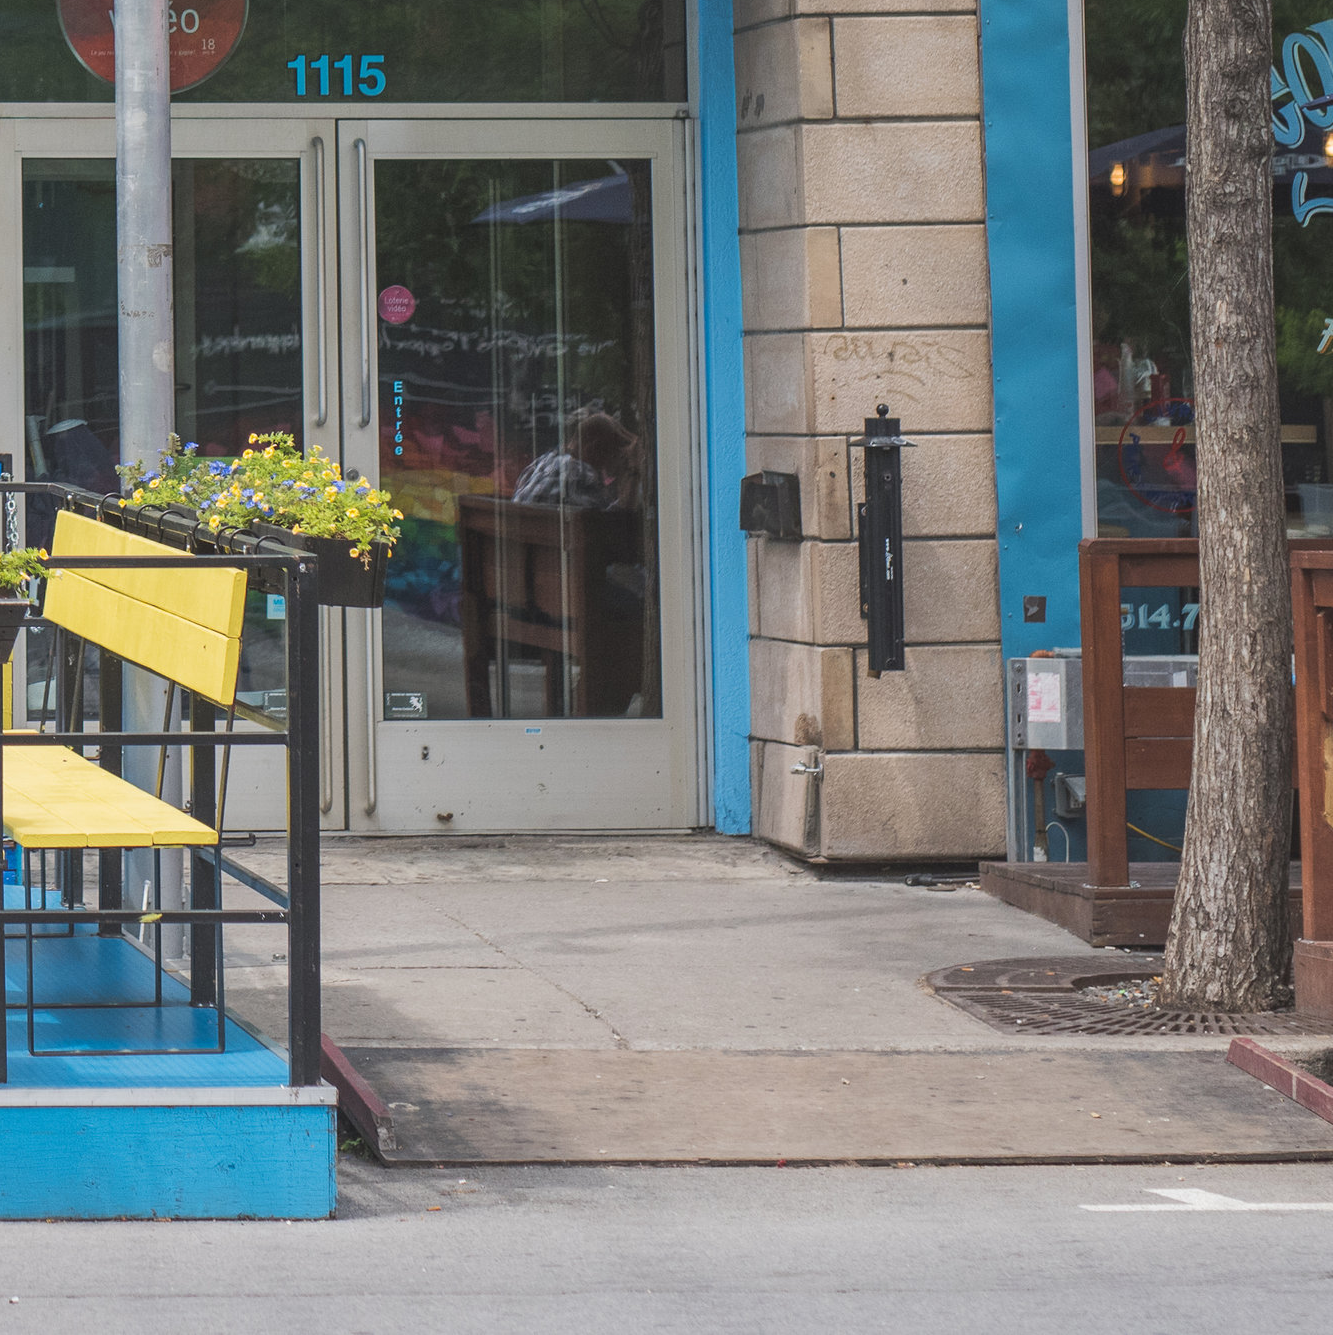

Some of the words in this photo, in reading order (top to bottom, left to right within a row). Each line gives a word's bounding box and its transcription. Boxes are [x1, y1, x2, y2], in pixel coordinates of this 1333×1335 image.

[201, 38, 216, 51] 18
[287, 54, 387, 97] 1115
[384, 296, 409, 305] Loterie
[393, 381, 403, 456] Entrée
